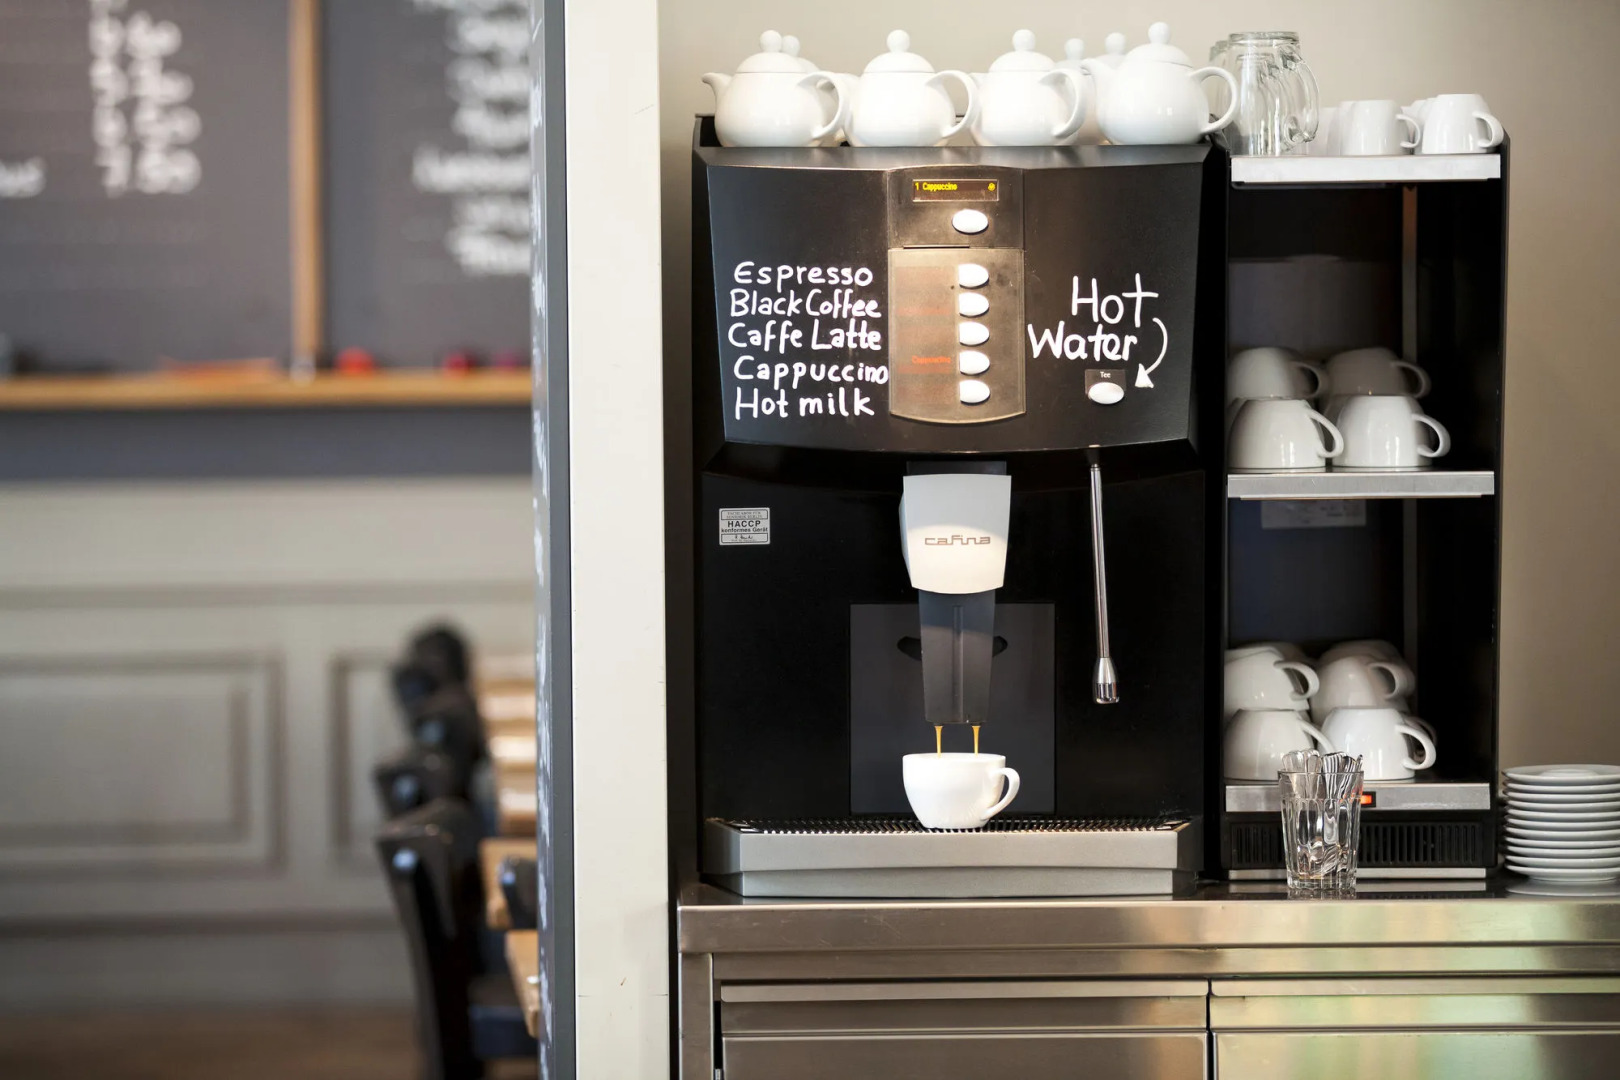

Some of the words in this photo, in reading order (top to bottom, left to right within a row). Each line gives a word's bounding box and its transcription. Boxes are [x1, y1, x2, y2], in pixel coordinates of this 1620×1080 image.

[922, 182, 958, 192] Cappuccino
[733, 261, 873, 292] Espresso
[730, 288, 802, 317] Black
[805, 288, 882, 319] Coffee
[1071, 272, 1159, 328] Hot
[728, 320, 803, 354] Caffe
[811, 318, 882, 350] Latte
[1027, 320, 1138, 362] Water
[733, 355, 889, 390] Cappuccino
[735, 387, 789, 420] Hot
[799, 387, 875, 417] milk
[727, 520, 761, 528] HACCP
[924, 534, 991, 546] cafina
